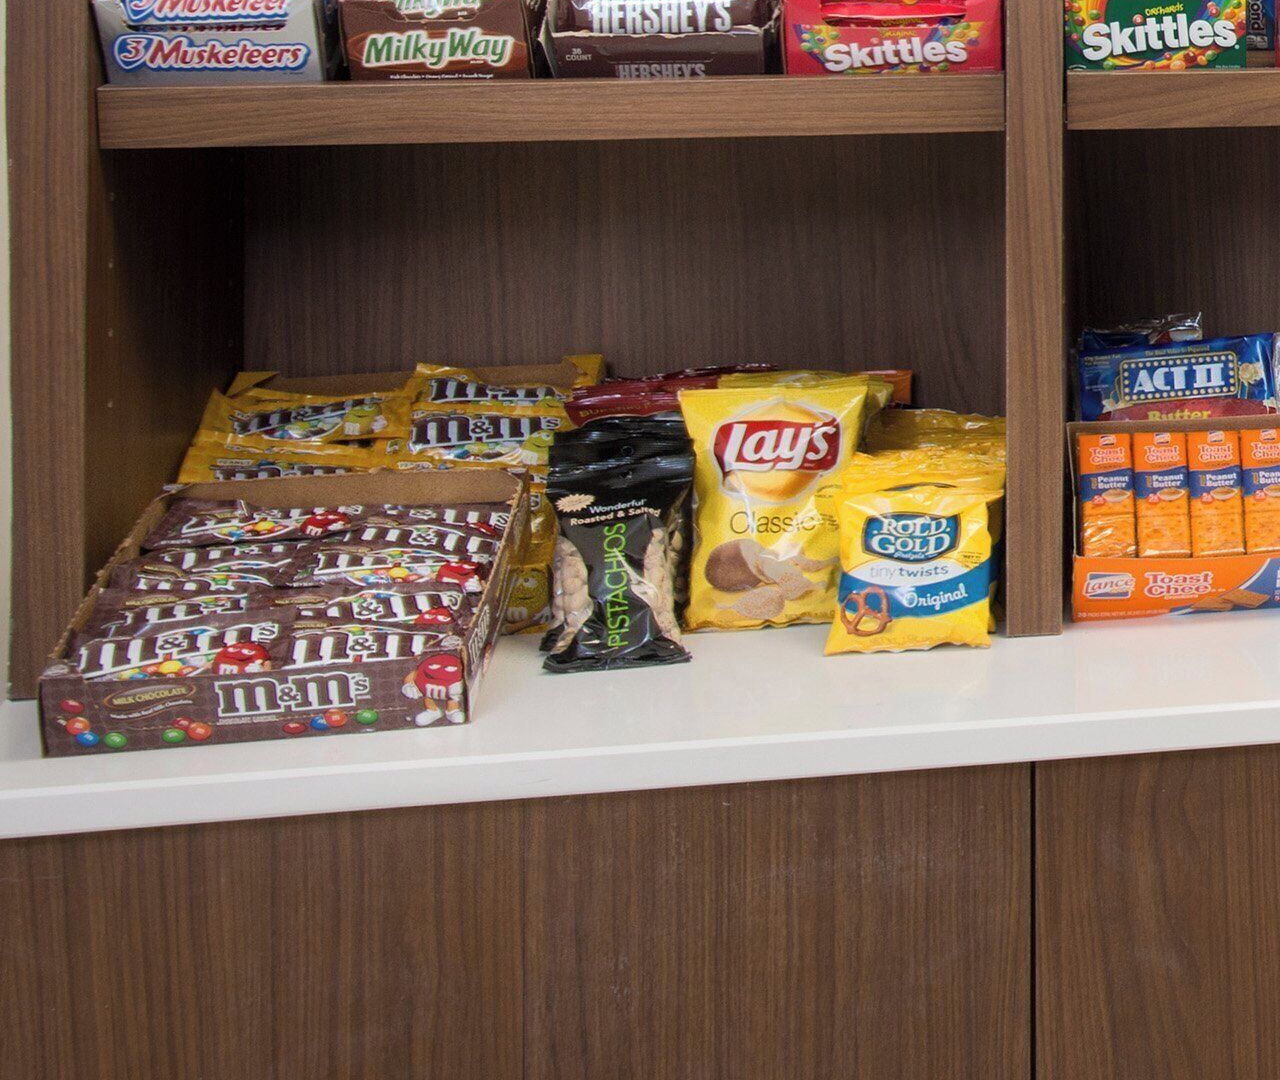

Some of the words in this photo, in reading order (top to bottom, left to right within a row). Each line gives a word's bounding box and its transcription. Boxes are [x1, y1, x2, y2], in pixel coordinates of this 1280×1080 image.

[1082, 13, 1239, 62] Skittles
[149, 38, 303, 67] Musketeers
[823, 36, 969, 72] Skittles
[1133, 366, 1186, 394] ACT
[1193, 362, 1225, 388] II
[723, 420, 837, 471] Lay's
[1206, 472, 1237, 481] Peanut
[1206, 478, 1235, 487] Butter
[570, 512, 615, 527] Roasted
[616, 510, 626, 519] &
[628, 506, 662, 519] Salted
[588, 498, 646, 515] Wonderful
[729, 510, 816, 535] Classic
[882, 516, 949, 537] ROLD
[870, 533, 952, 556] GOLD
[898, 564, 949, 578] twists
[1144, 571, 1213, 587] Toast
[604, 522, 629, 648] PISTACHIOS
[1084, 572, 1136, 595] Lance
[1144, 584, 1211, 599] Chee
[903, 582, 968, 610] Original
